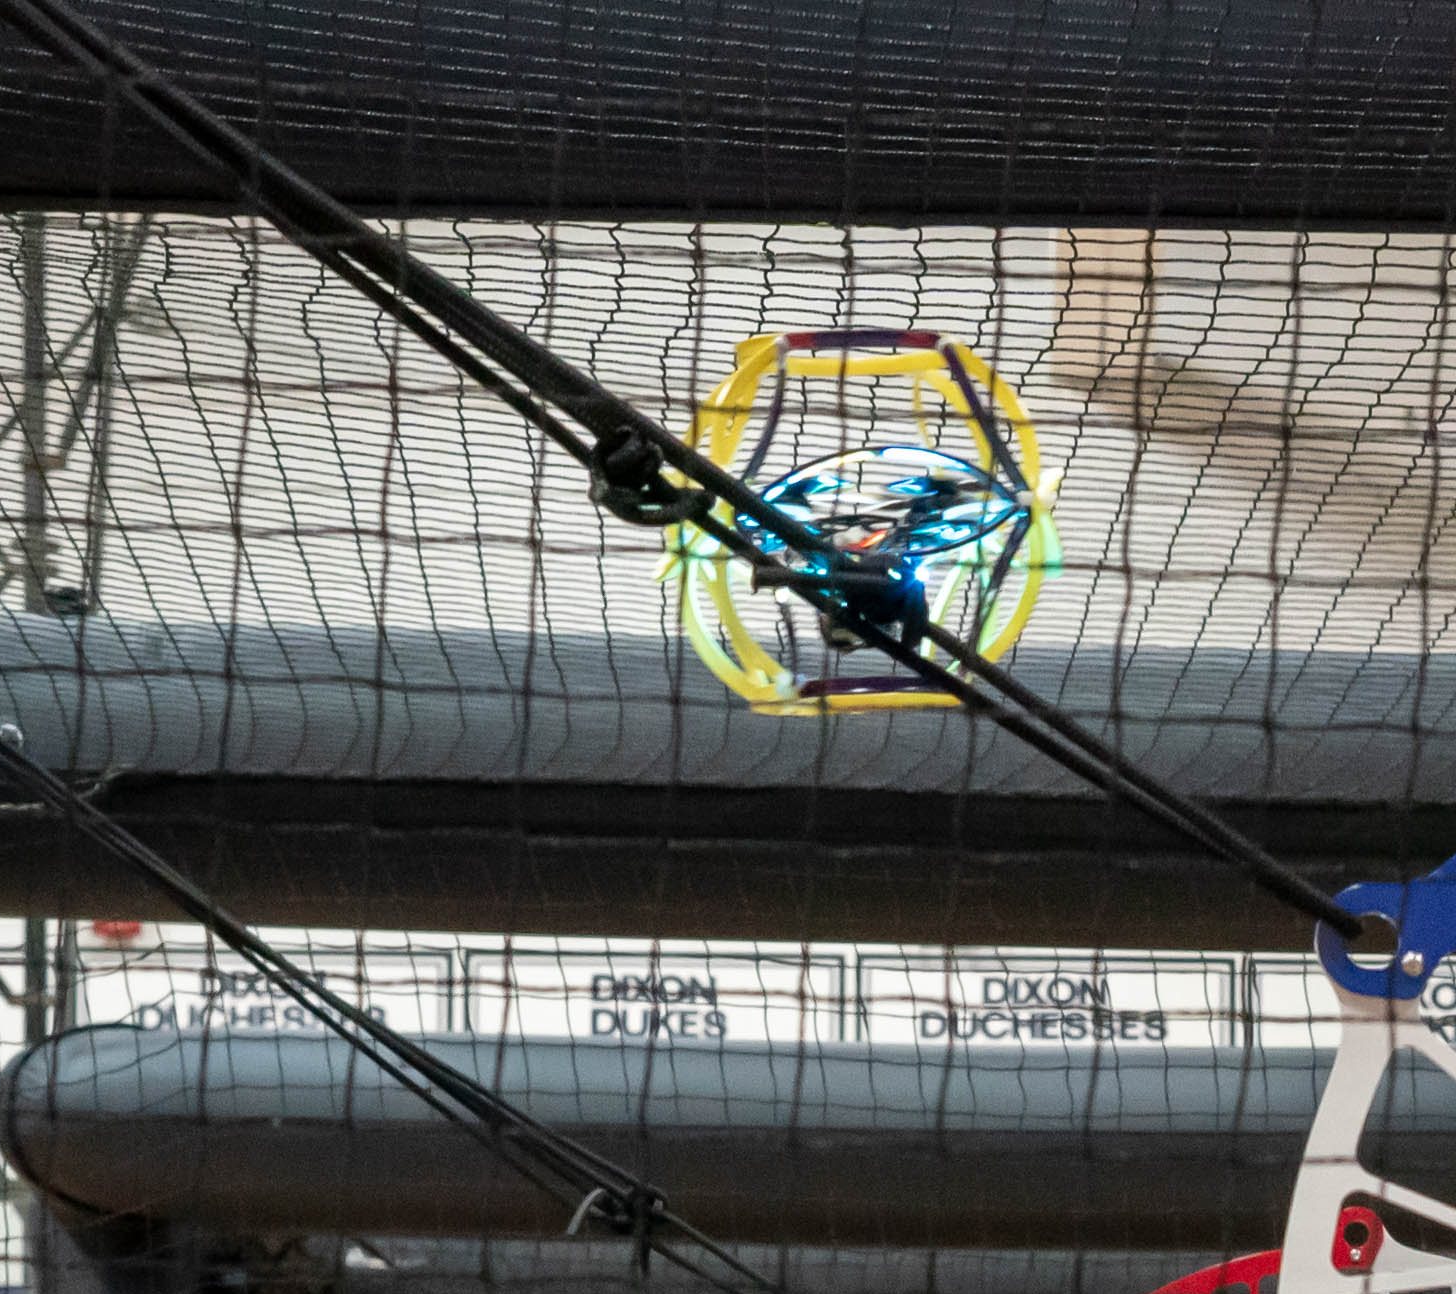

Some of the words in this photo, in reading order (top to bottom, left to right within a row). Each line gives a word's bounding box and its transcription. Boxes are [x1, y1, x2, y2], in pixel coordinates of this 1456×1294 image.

[591, 974, 718, 1005] DIXON
[984, 977, 1109, 1006] DIXON
[591, 1008, 727, 1038] DUKES
[920, 1011, 1170, 1041] DUCHESSES
